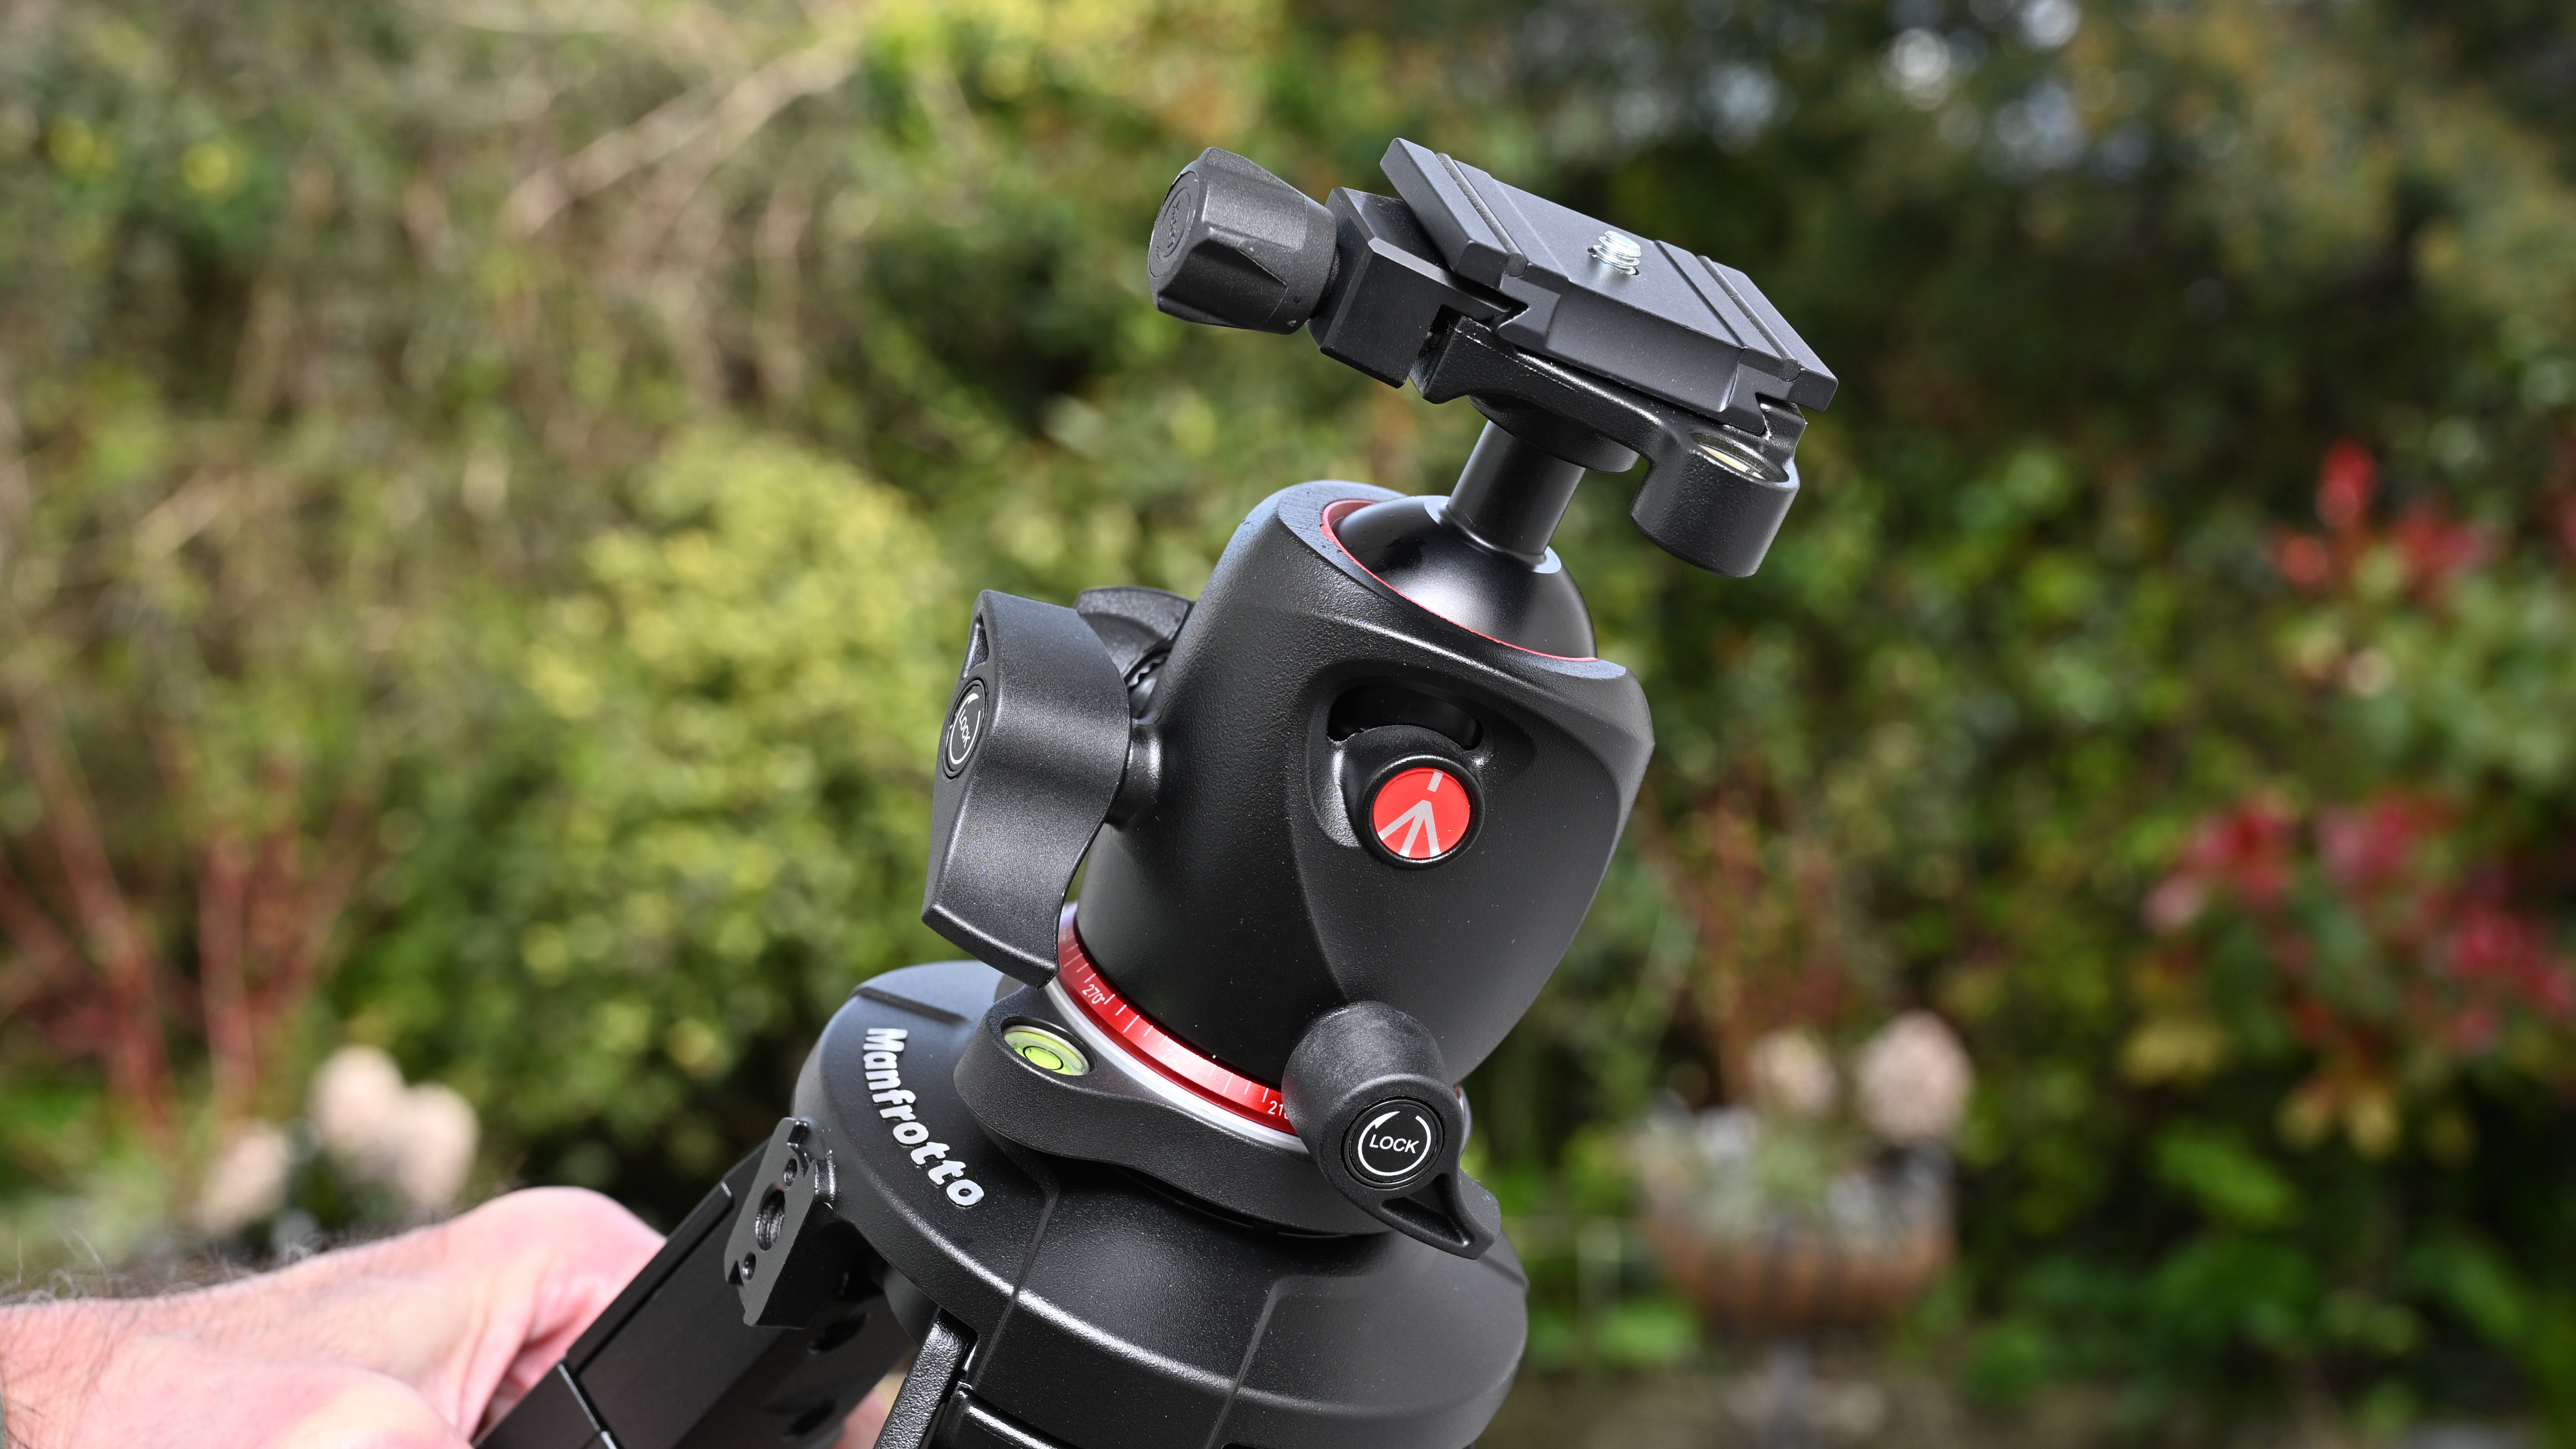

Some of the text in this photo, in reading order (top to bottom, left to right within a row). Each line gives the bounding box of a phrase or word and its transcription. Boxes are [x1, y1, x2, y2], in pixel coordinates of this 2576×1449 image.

[959, 709, 970, 749] LOCK
[863, 1027, 984, 1206] Manfrotto
[1369, 1134, 1419, 1154] LOCK
